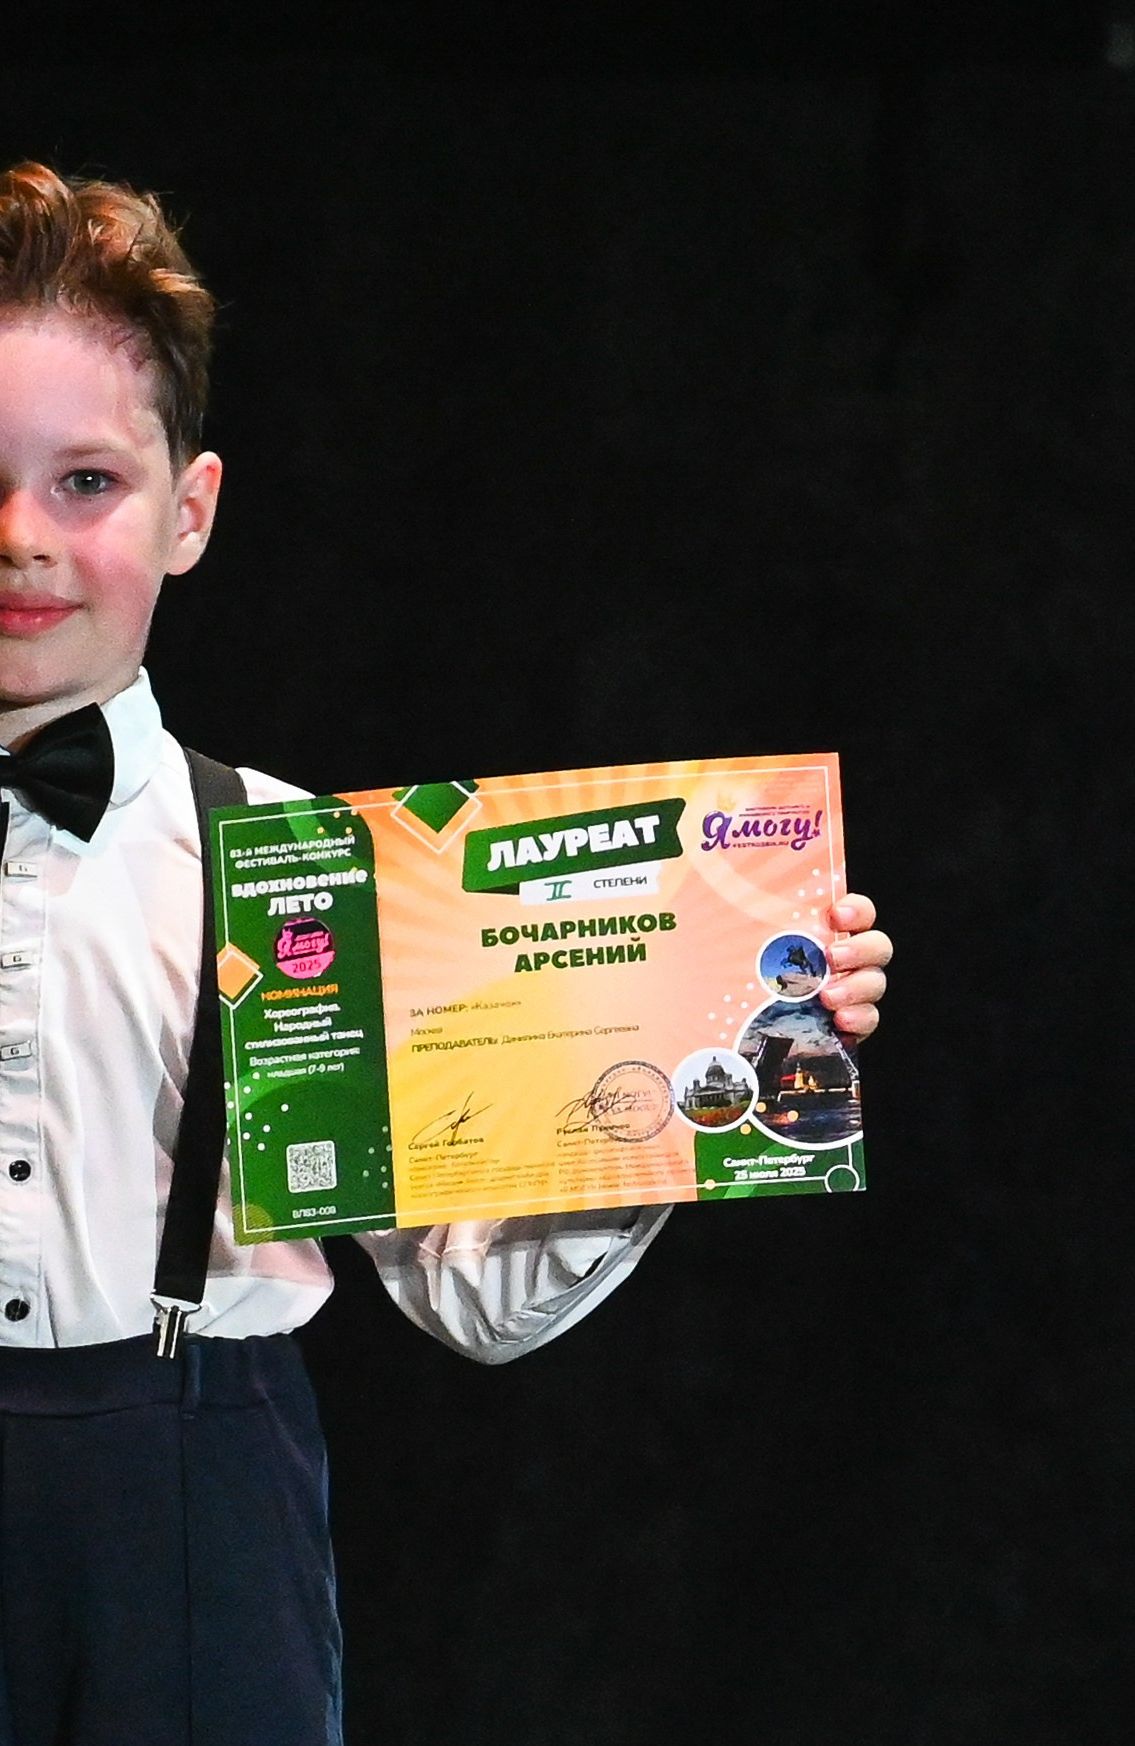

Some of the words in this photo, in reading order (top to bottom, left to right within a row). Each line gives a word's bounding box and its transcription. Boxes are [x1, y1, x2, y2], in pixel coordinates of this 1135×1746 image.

[701, 810, 733, 851] Я
[732, 809, 823, 851] могу!
[254, 834, 355, 856] МЕЖДУНАРОДНЫЙ
[487, 815, 660, 872] ЛАУРЕАТ
[234, 848, 351, 869] ФЕСТИВАЛЬ-КОНКУРС
[593, 876, 648, 889] СТЕПЕНИ
[267, 891, 334, 916] ЛЕТО
[481, 912, 677, 947] БОЧАРНИКОВ
[514, 937, 647, 973] АРСЕНИЙ
[292, 959, 322, 974] 2025
[261, 984, 338, 1001] НОМИНАЦИЯ
[410, 1008, 424, 1017] ЗА
[426, 1003, 468, 1016] НОМЕР:
[274, 1017, 332, 1032] Народный
[411, 1037, 498, 1053] ПРЕПОДАВАТЕЛЬ:
[249, 1053, 307, 1067] Возрастная
[723, 1153, 816, 1168] Санкт-Петербург
[779, 1166, 806, 1178] 2025
